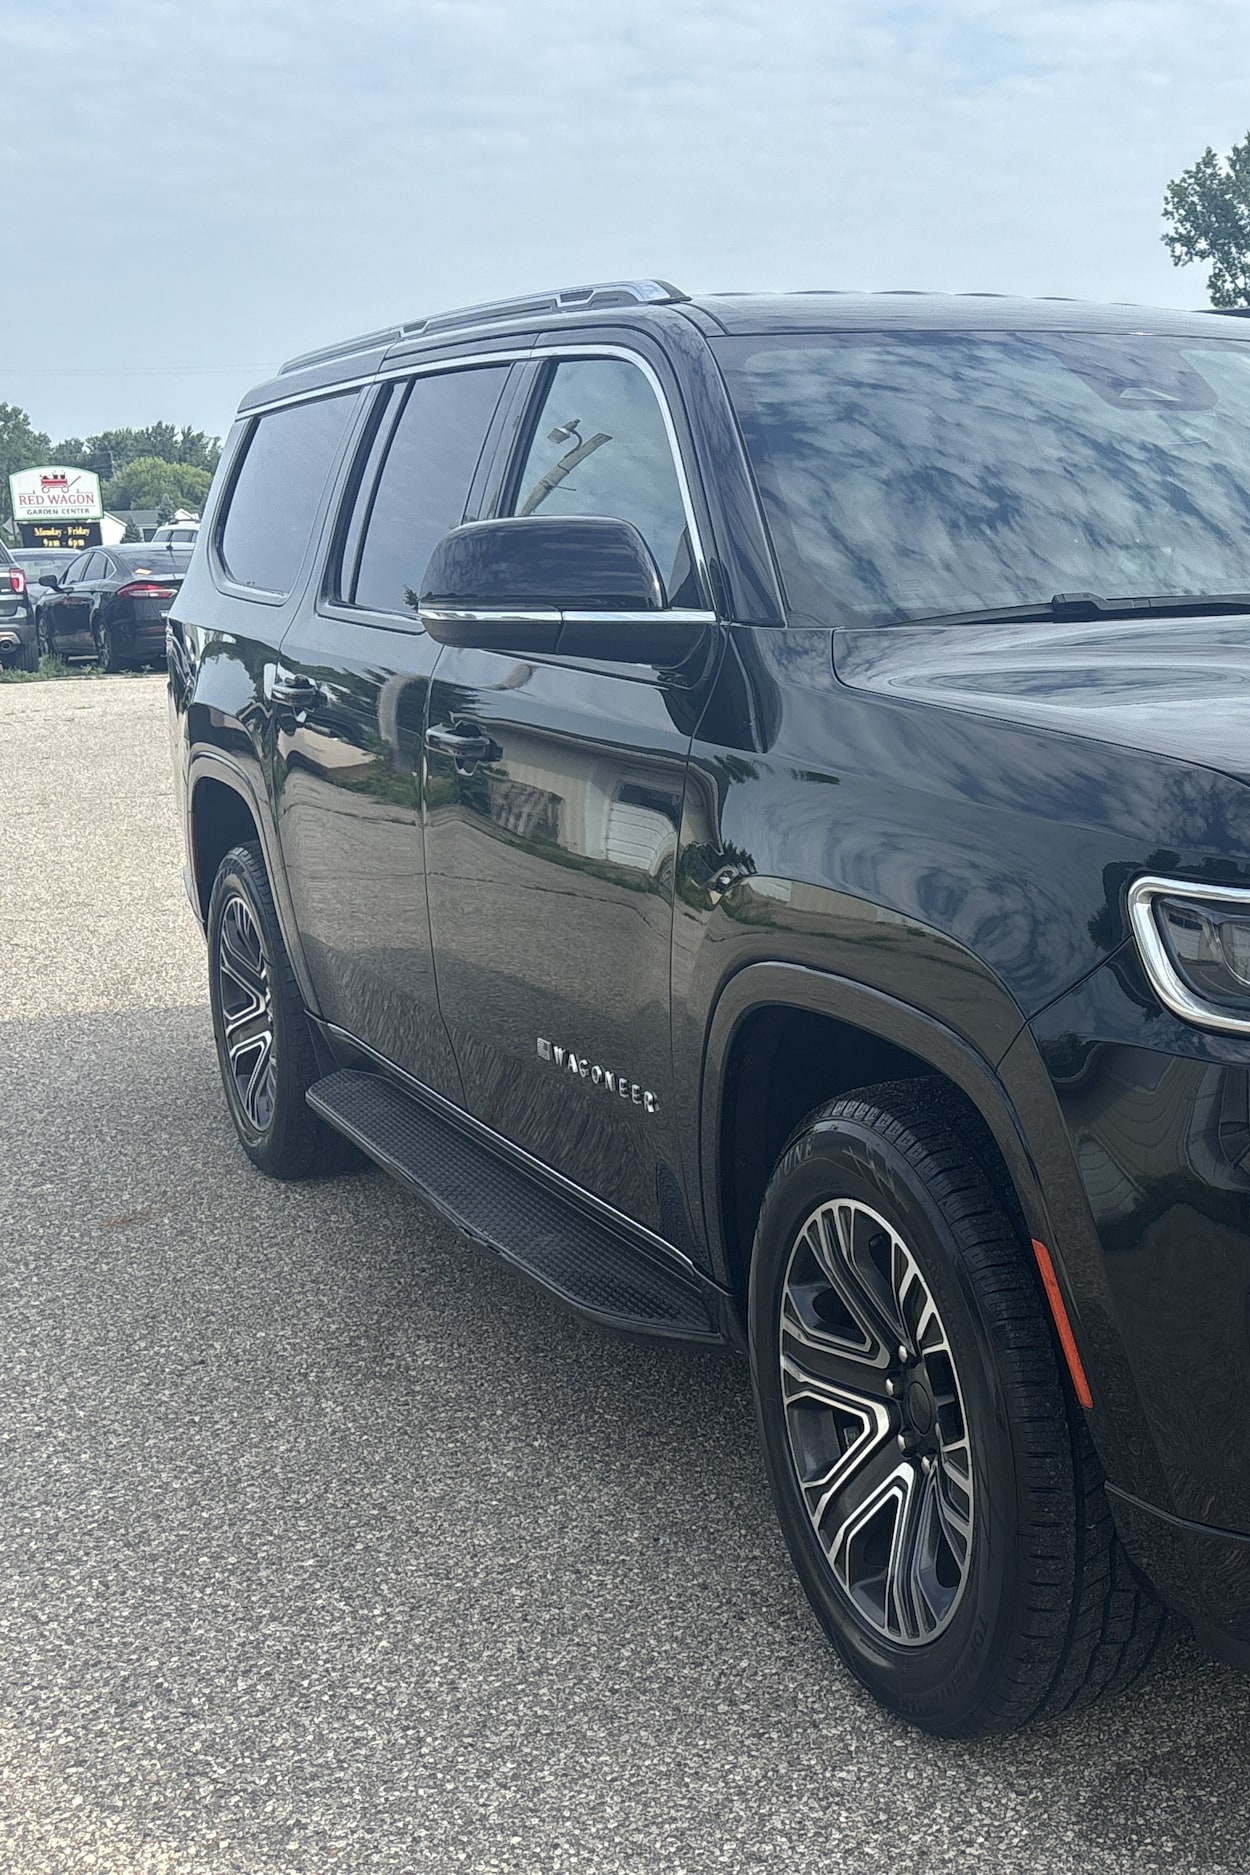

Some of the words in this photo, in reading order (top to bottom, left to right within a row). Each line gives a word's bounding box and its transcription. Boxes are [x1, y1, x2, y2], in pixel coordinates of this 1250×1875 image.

[19, 495, 44, 505] RED
[48, 494, 95, 505] WAGON
[34, 527, 62, 537] Monday
[67, 526, 90, 537] Friday
[43, 539, 60, 547] 9am
[68, 538, 85, 548] 6pm
[553, 1046, 657, 1112] WAGONEER
